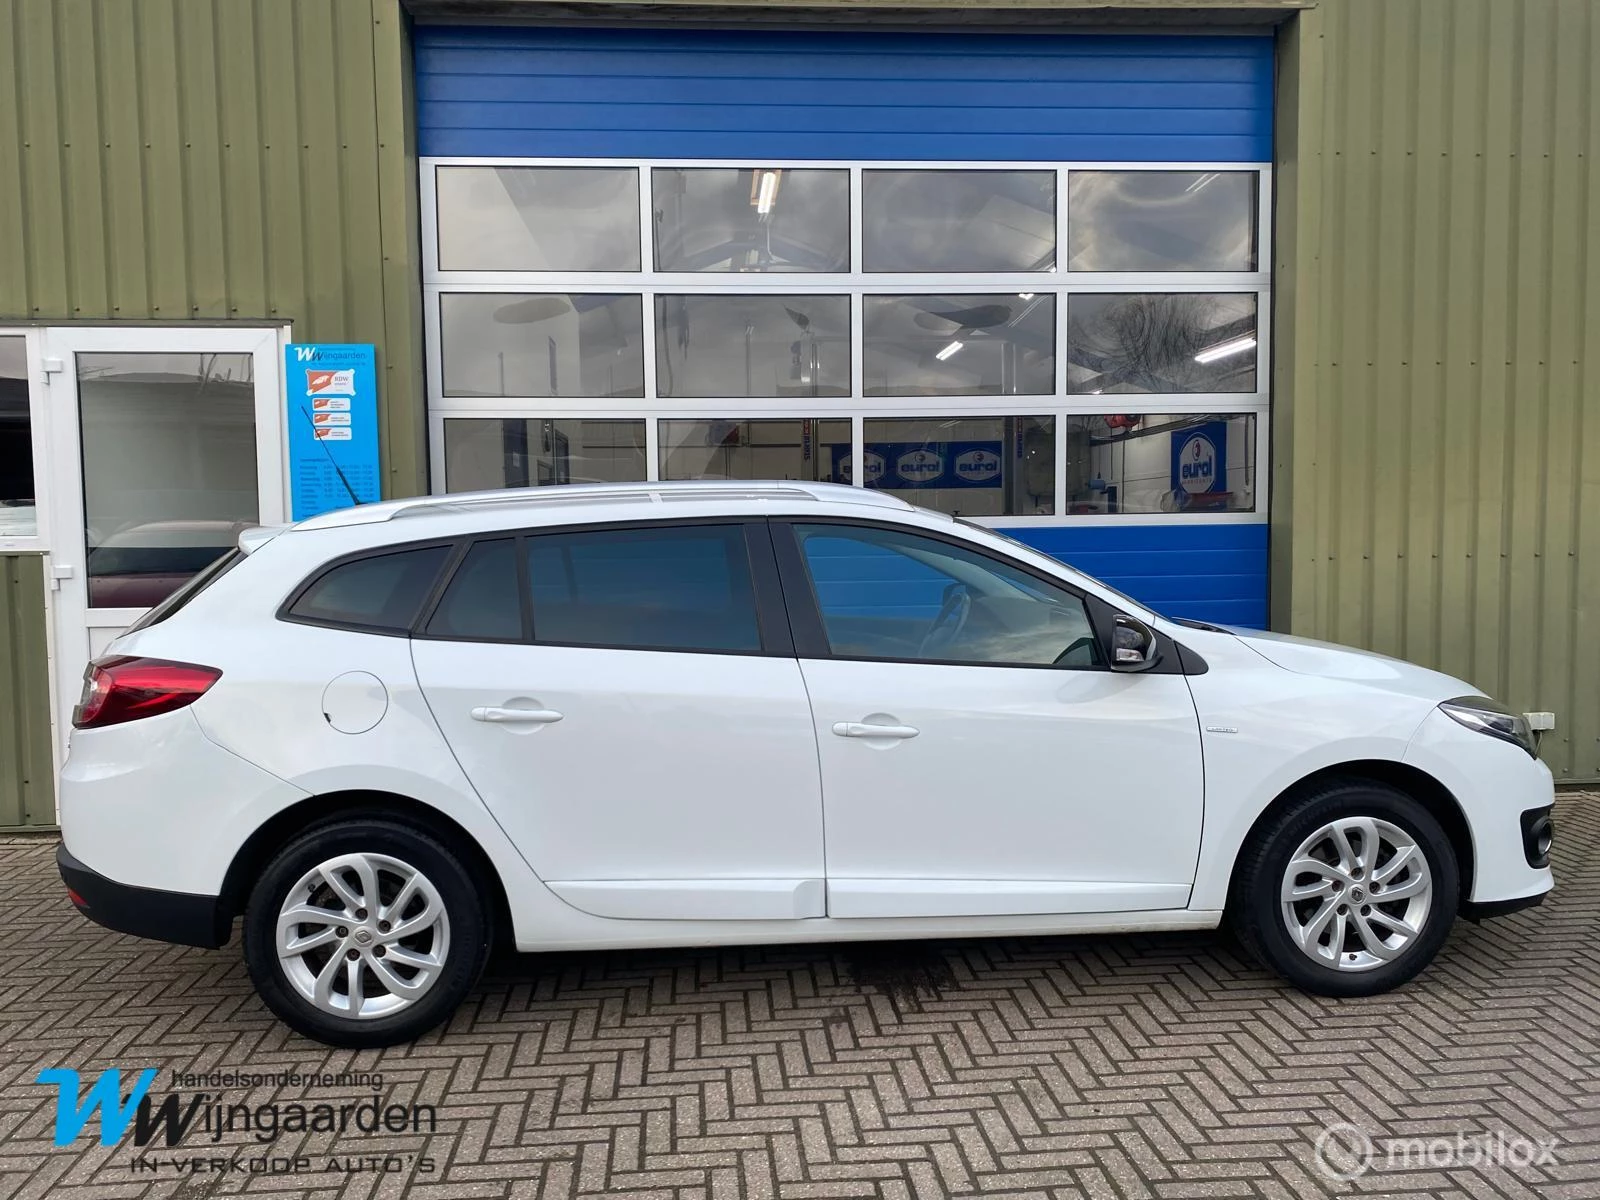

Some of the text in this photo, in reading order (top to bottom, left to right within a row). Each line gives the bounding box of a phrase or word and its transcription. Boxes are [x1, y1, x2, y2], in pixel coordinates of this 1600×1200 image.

[902, 461, 940, 472] eurol
[959, 461, 998, 471] eurol
[1183, 456, 1212, 479] eurol
